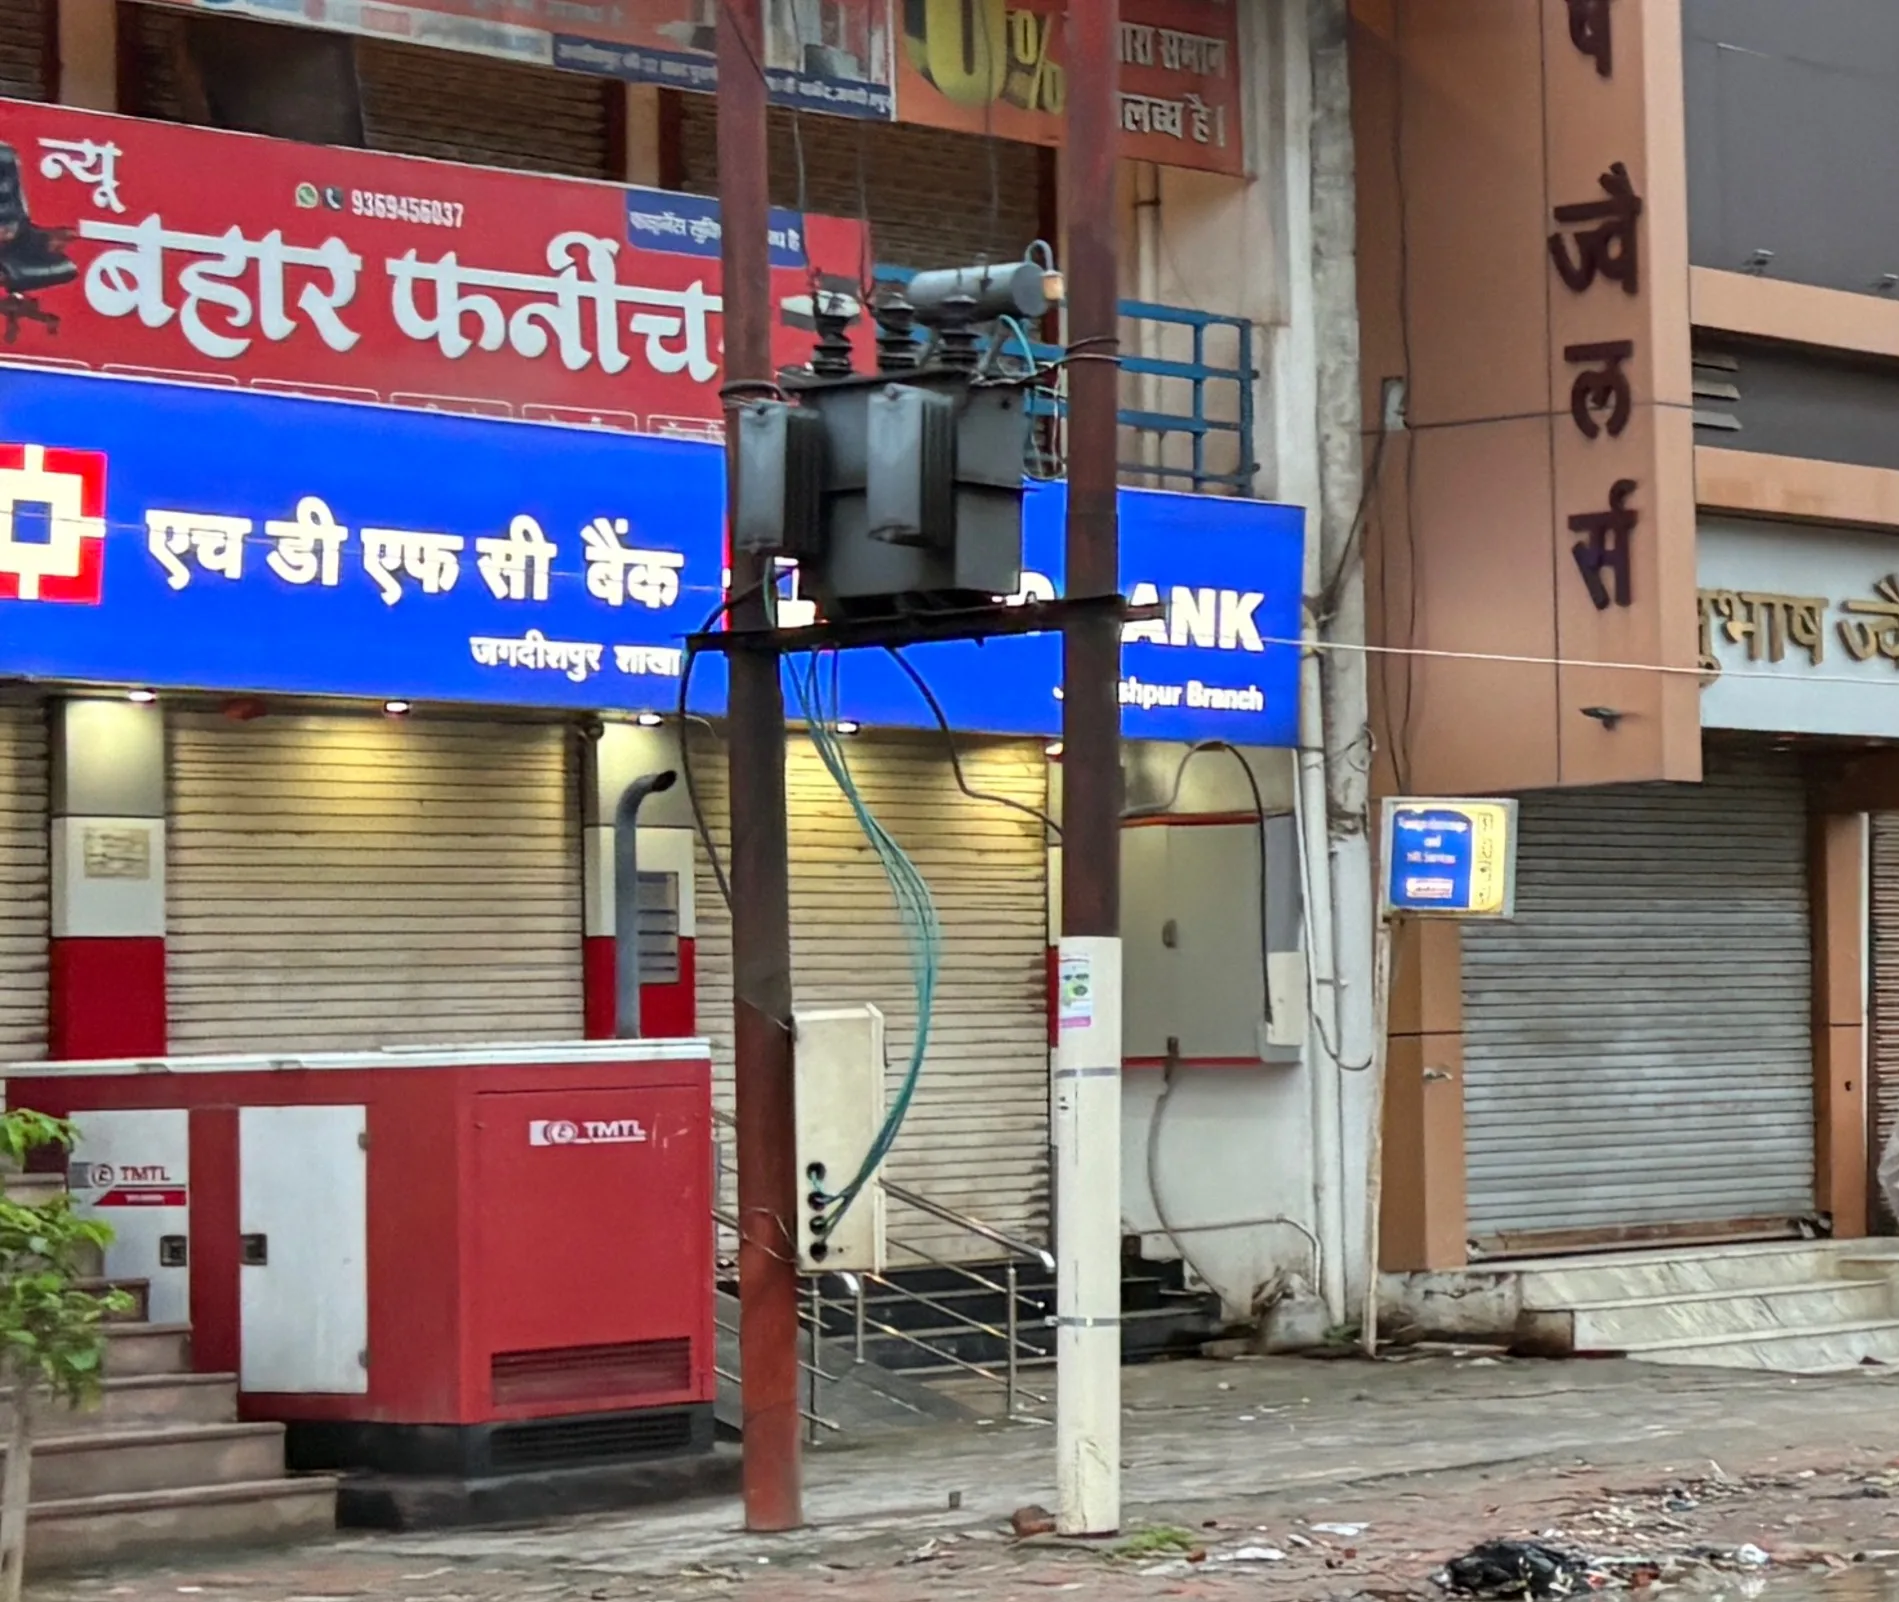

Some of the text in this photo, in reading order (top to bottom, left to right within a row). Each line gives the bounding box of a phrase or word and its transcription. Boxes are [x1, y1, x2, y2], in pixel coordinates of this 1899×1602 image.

[38, 137, 127, 214] न्यू
[350, 188, 465, 229] 9369456037
[78, 212, 735, 386] बहार फर्नीच
[145, 508, 252, 590] एच
[265, 496, 348, 586] डी
[361, 528, 464, 606] एफ
[476, 514, 557, 601] सी
[581, 517, 685, 609] बैंक
[1119, 582, 1265, 652] ANK
[469, 634, 683, 682] जगदीशपुर शाखा
[1186, 679, 1264, 712] Branch
[582, 1119, 647, 1137] TMTL
[119, 1165, 171, 1182] TMTL
